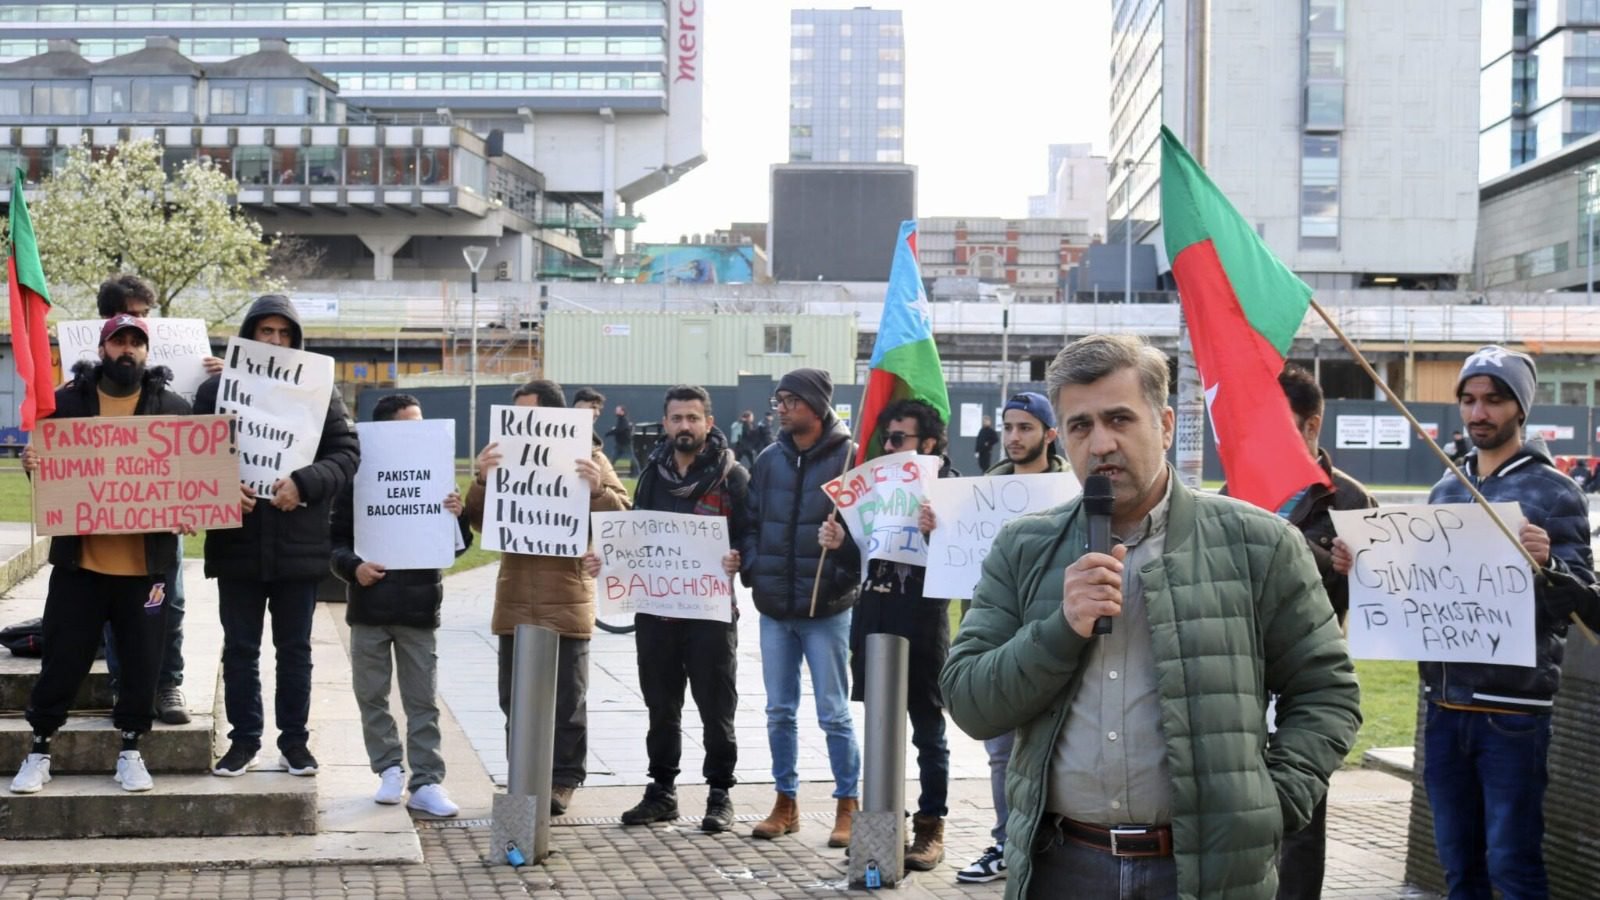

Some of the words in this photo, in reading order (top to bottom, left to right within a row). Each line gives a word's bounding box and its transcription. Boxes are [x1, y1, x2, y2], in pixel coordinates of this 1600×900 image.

[67, 325, 93, 347] NO
[501, 408, 578, 438] Release
[40, 457, 104, 480] HUMAN
[115, 456, 170, 477] RIGHTS
[378, 469, 431, 482] PAKISTAN
[88, 479, 218, 503] VIOLATION
[387, 486, 421, 499] LEAVE
[496, 467, 568, 498] Baloch
[972, 479, 1030, 513] NO
[46, 509, 63, 527] IN
[76, 502, 241, 535] BALOCHISTAN
[367, 503, 441, 516] BALOCHISTAN
[496, 498, 580, 537] Missing
[499, 526, 578, 556] Persons
[601, 520, 625, 539] 27
[683, 521, 722, 540] 1948
[957, 518, 1004, 541] MO
[1363, 509, 1463, 556] STOP
[602, 543, 681, 566] PAKISTAN
[628, 559, 701, 570] OCCUPIED
[1355, 548, 1467, 595] GIVING
[1477, 563, 1528, 597] AID
[606, 573, 731, 600] BALOCHISTAN
[1402, 598, 1512, 628] PAKISTANI
